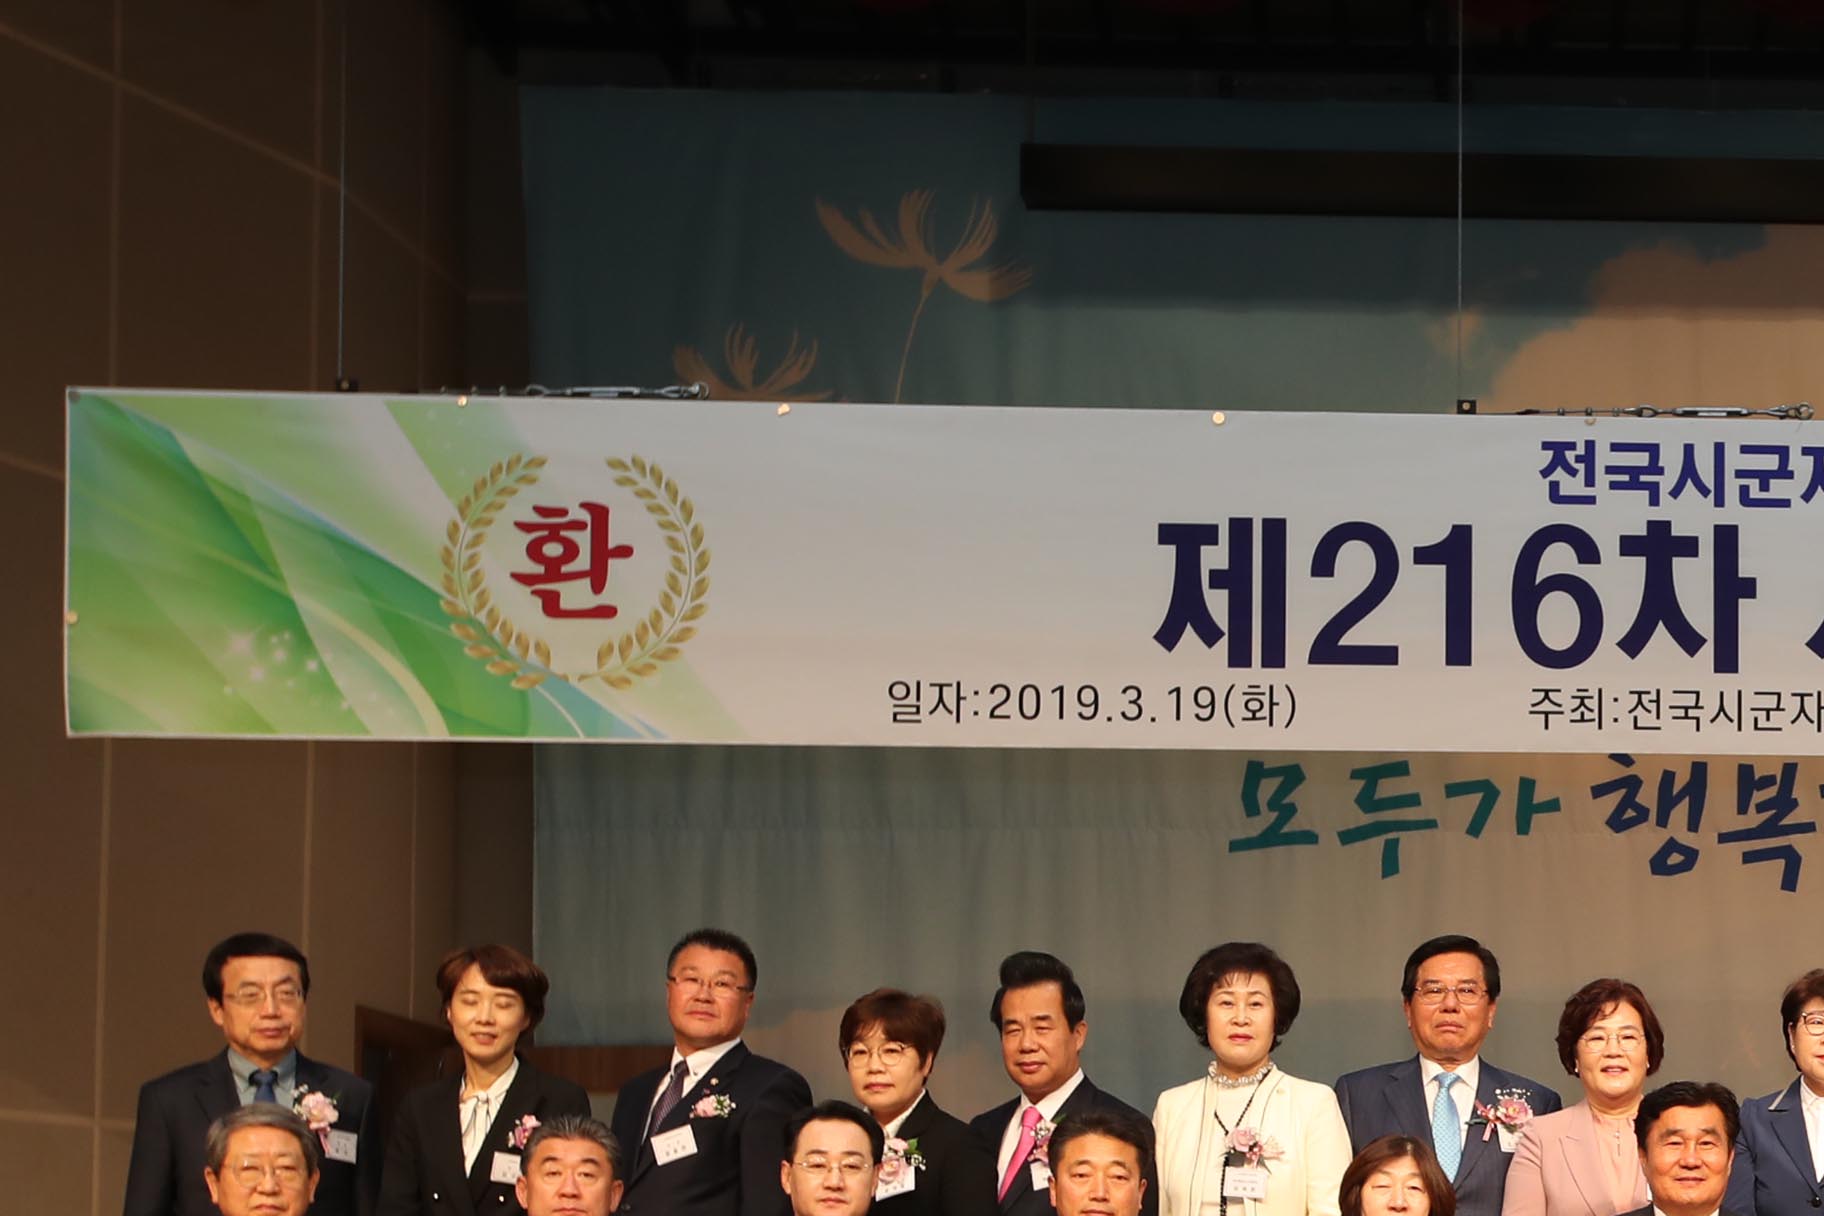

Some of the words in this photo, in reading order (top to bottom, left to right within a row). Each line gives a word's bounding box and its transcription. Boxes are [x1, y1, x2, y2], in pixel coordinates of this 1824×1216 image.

[510, 502, 634, 619] 환
[1152, 516, 1757, 675] 제216차
[887, 679, 1296, 729] 일자:2019.3.19(화)
[1227, 759, 1562, 880] 모두가
